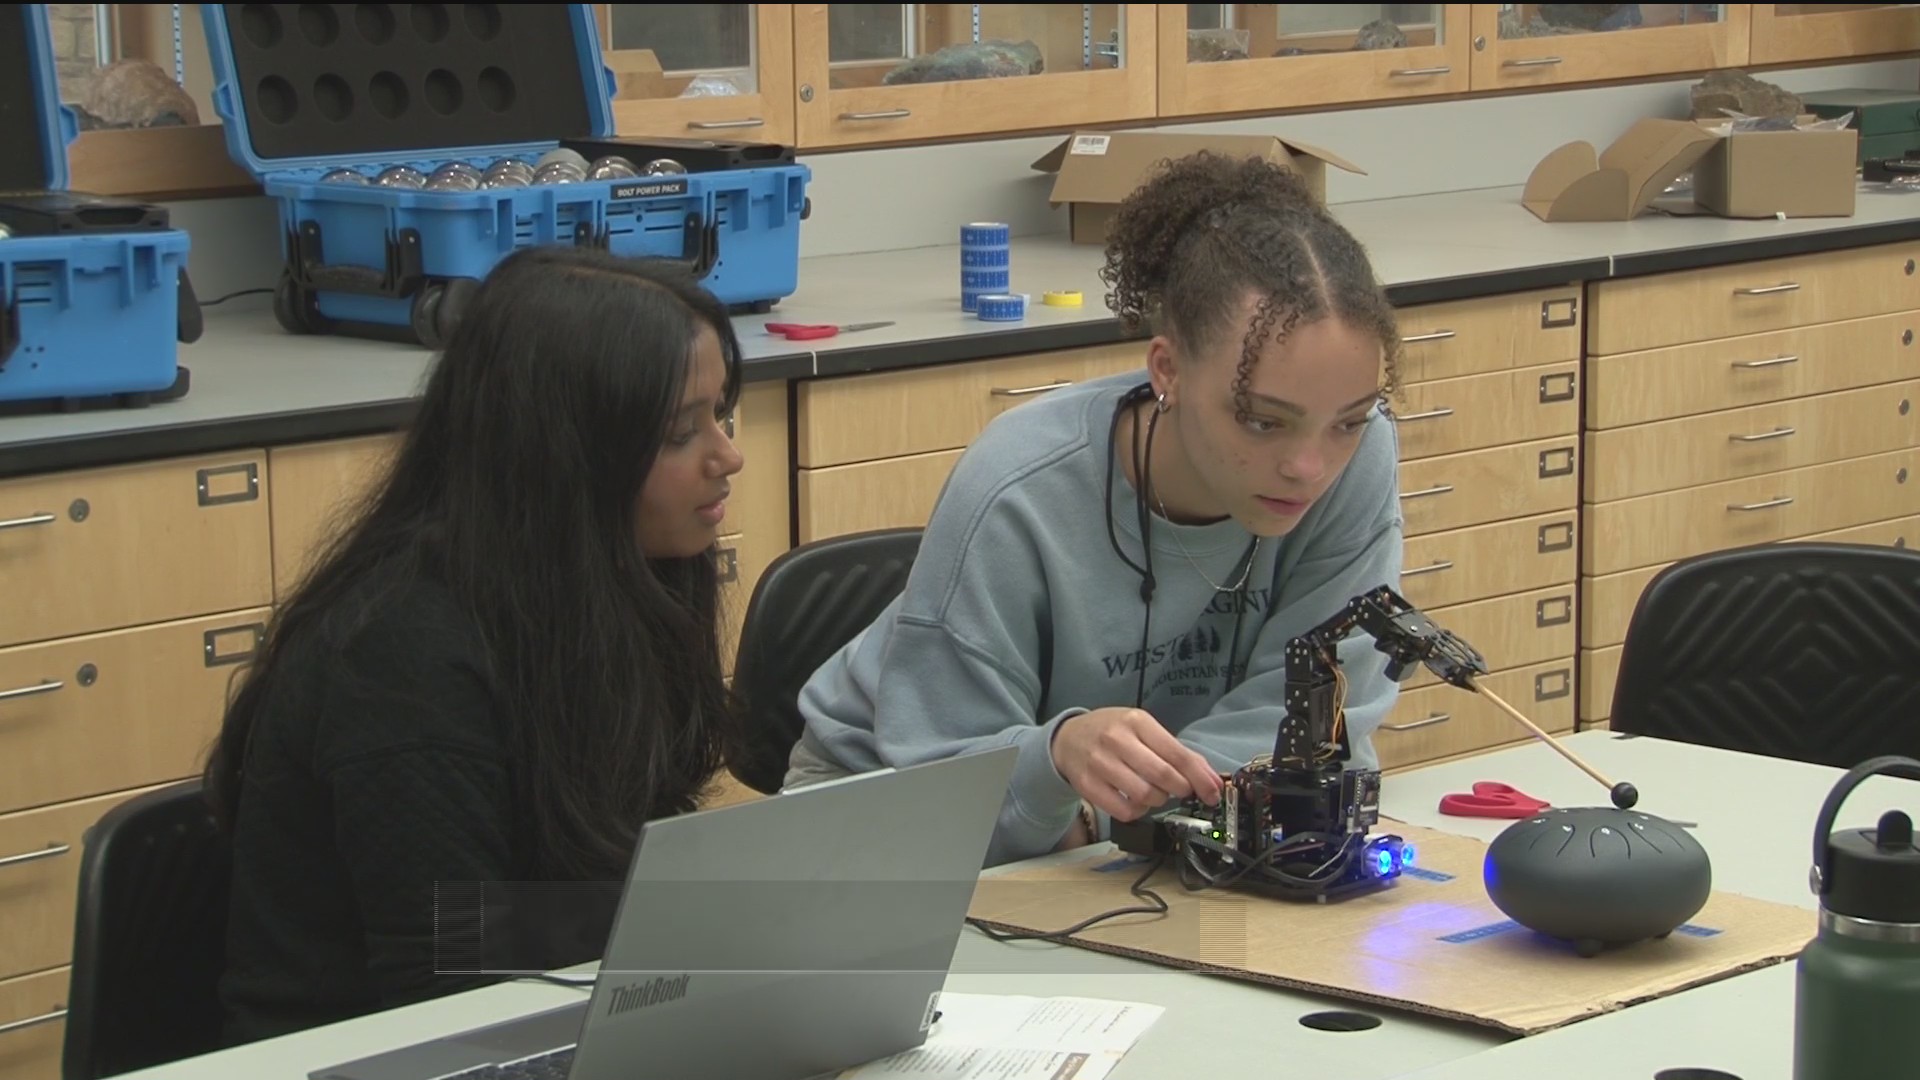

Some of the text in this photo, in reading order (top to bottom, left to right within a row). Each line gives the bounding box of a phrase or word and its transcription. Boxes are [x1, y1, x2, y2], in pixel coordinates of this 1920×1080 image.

[617, 184, 680, 197] BOLT POWER PACK
[1102, 633, 1185, 679] WEST
[607, 973, 691, 1016] ThinkBook
